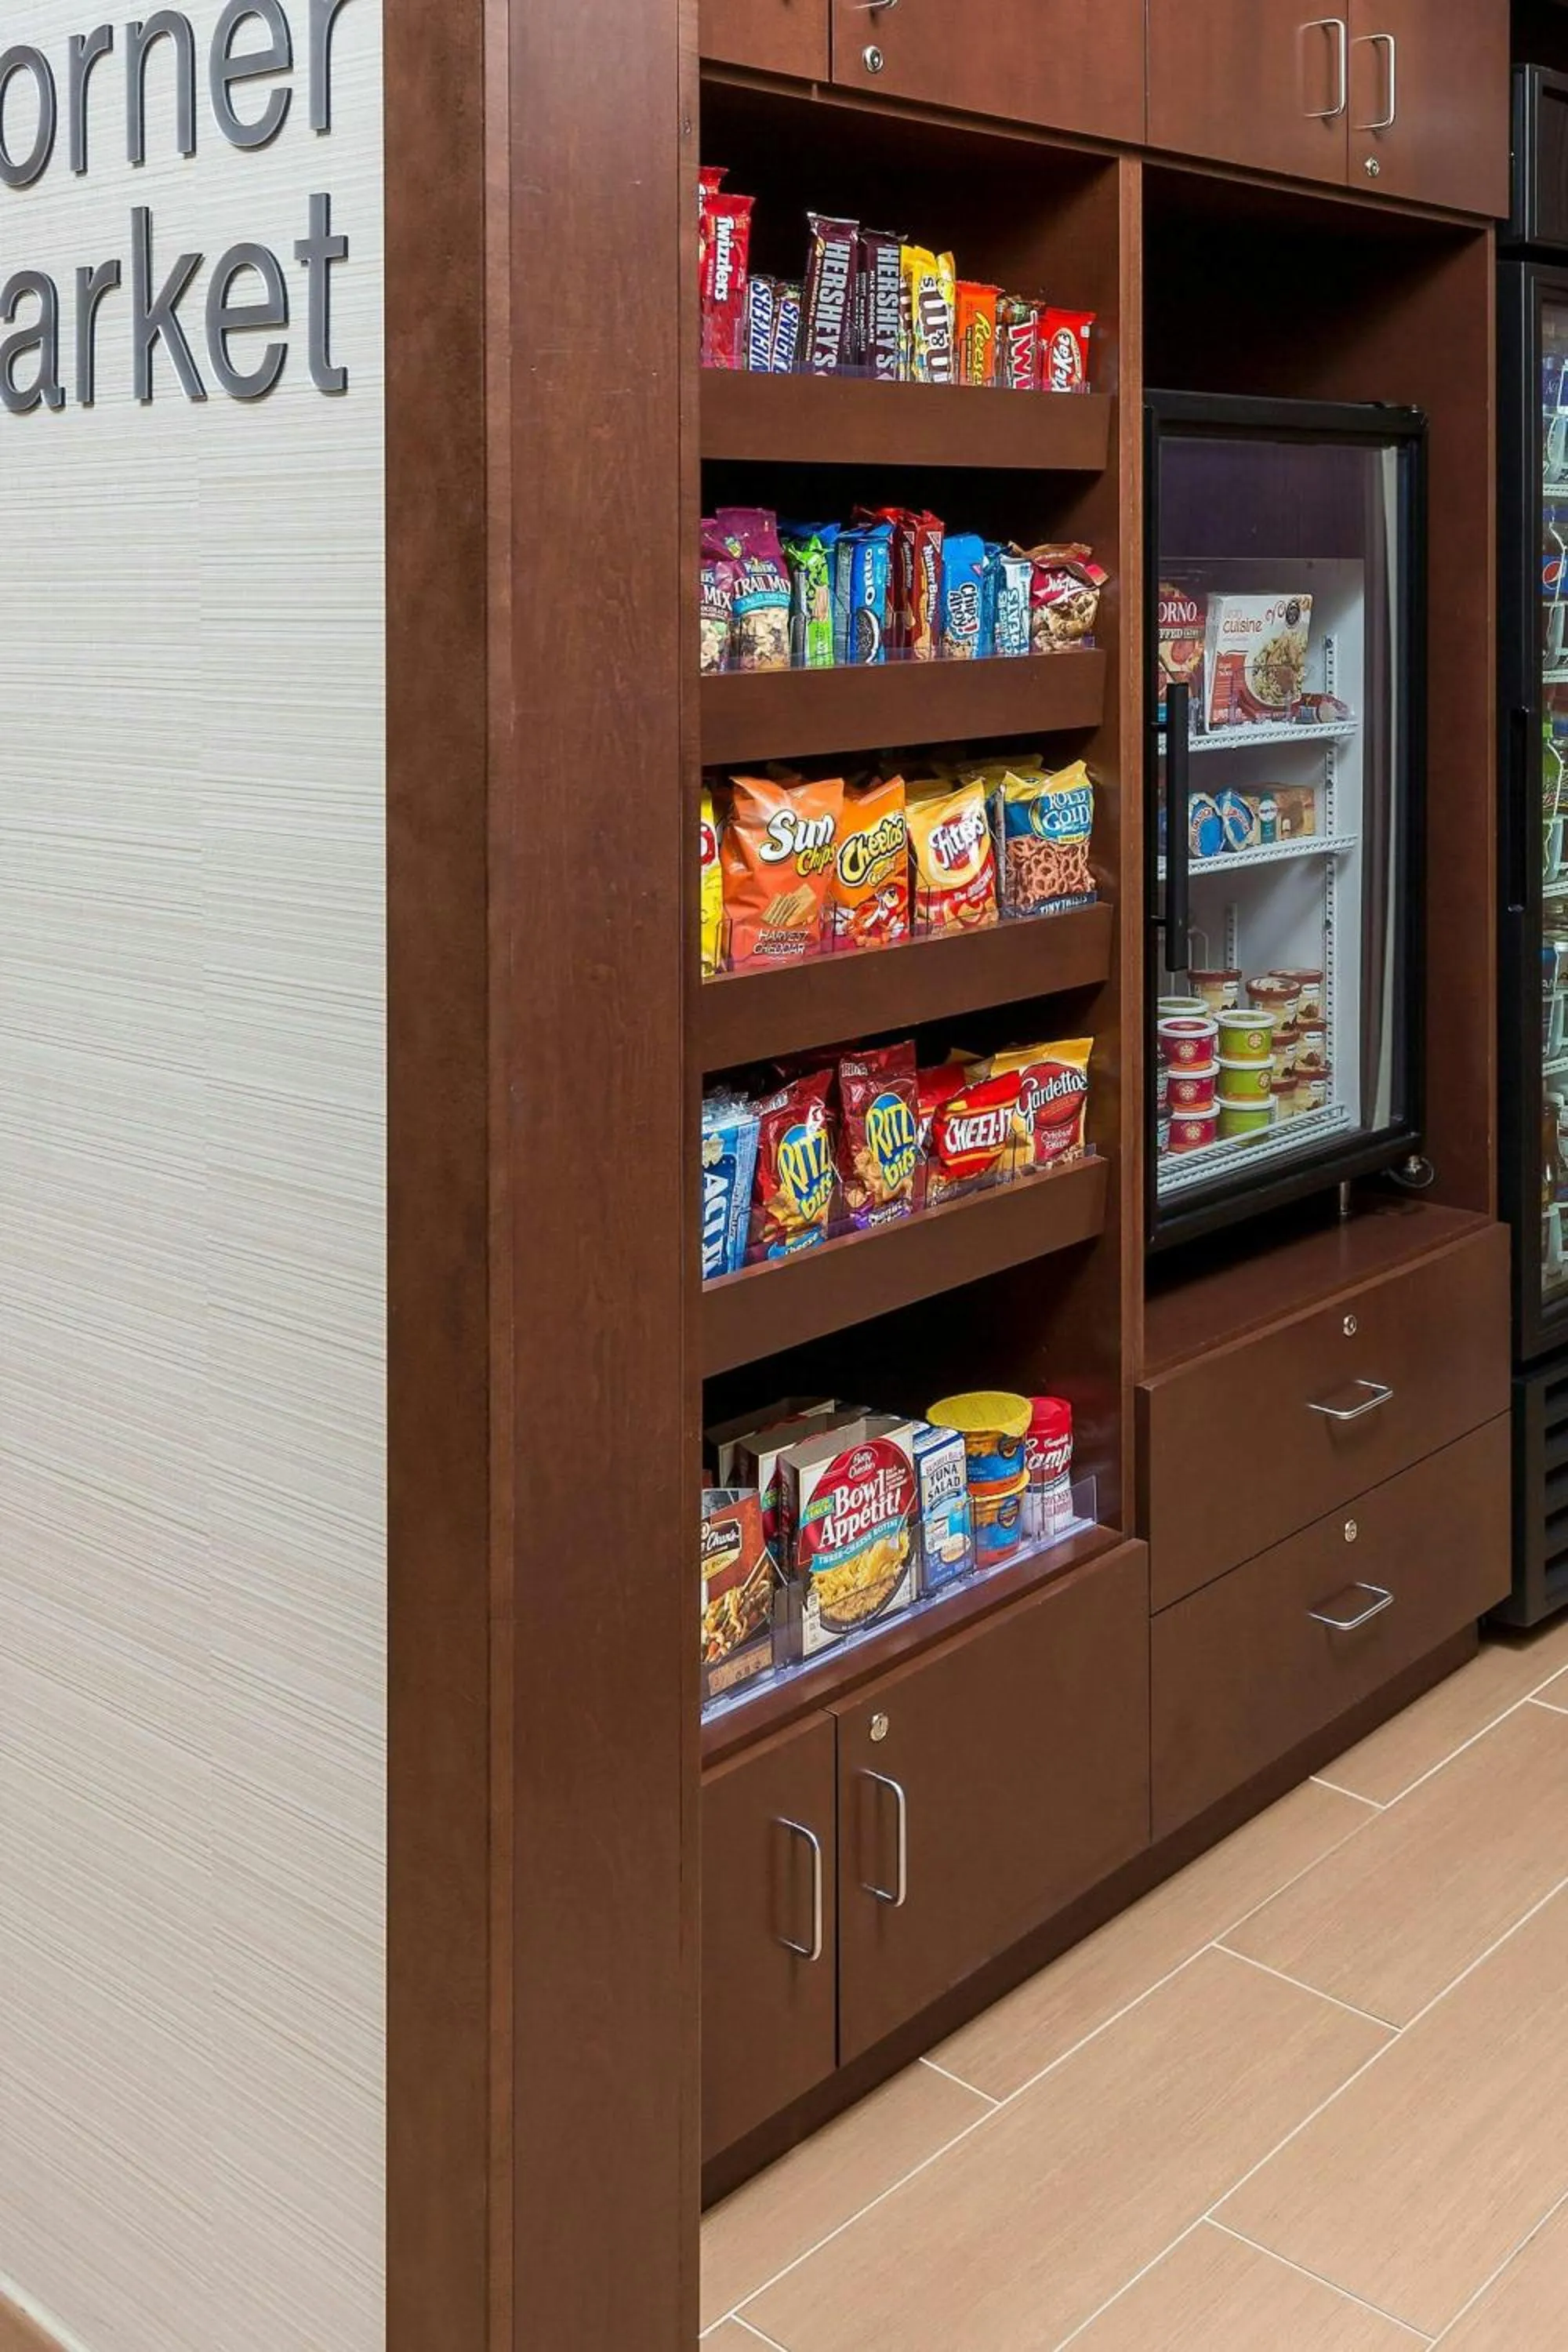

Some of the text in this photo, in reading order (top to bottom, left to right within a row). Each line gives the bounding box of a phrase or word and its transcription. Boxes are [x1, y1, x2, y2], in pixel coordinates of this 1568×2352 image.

[714, 216, 735, 302] Twizzlers
[0, 193, 348, 411] arket
[750, 280, 773, 372] NICKERS
[813, 240, 851, 368] HERSHEY'S
[875, 247, 899, 369] HERSHEY'S
[773, 300, 799, 373] SNICK
[973, 310, 992, 385] Reese
[1008, 310, 1037, 390] TWI
[960, 584, 978, 624] Chips
[1043, 804, 1091, 831] GOLD
[1047, 788, 1087, 810] ROLD
[759, 809, 836, 862] Sun
[840, 815, 905, 885] Cheetos
[779, 1129, 832, 1192] RITZ
[868, 1102, 914, 1160] RITZ
[945, 1108, 1014, 1154] CHEEZ-IT
[883, 1145, 917, 1189] bits
[833, 1468, 888, 1519] Bowl
[927, 1477, 961, 1503] SALAD
[930, 1464, 958, 1486] TUNA
[818, 1487, 902, 1549] Appétit!
